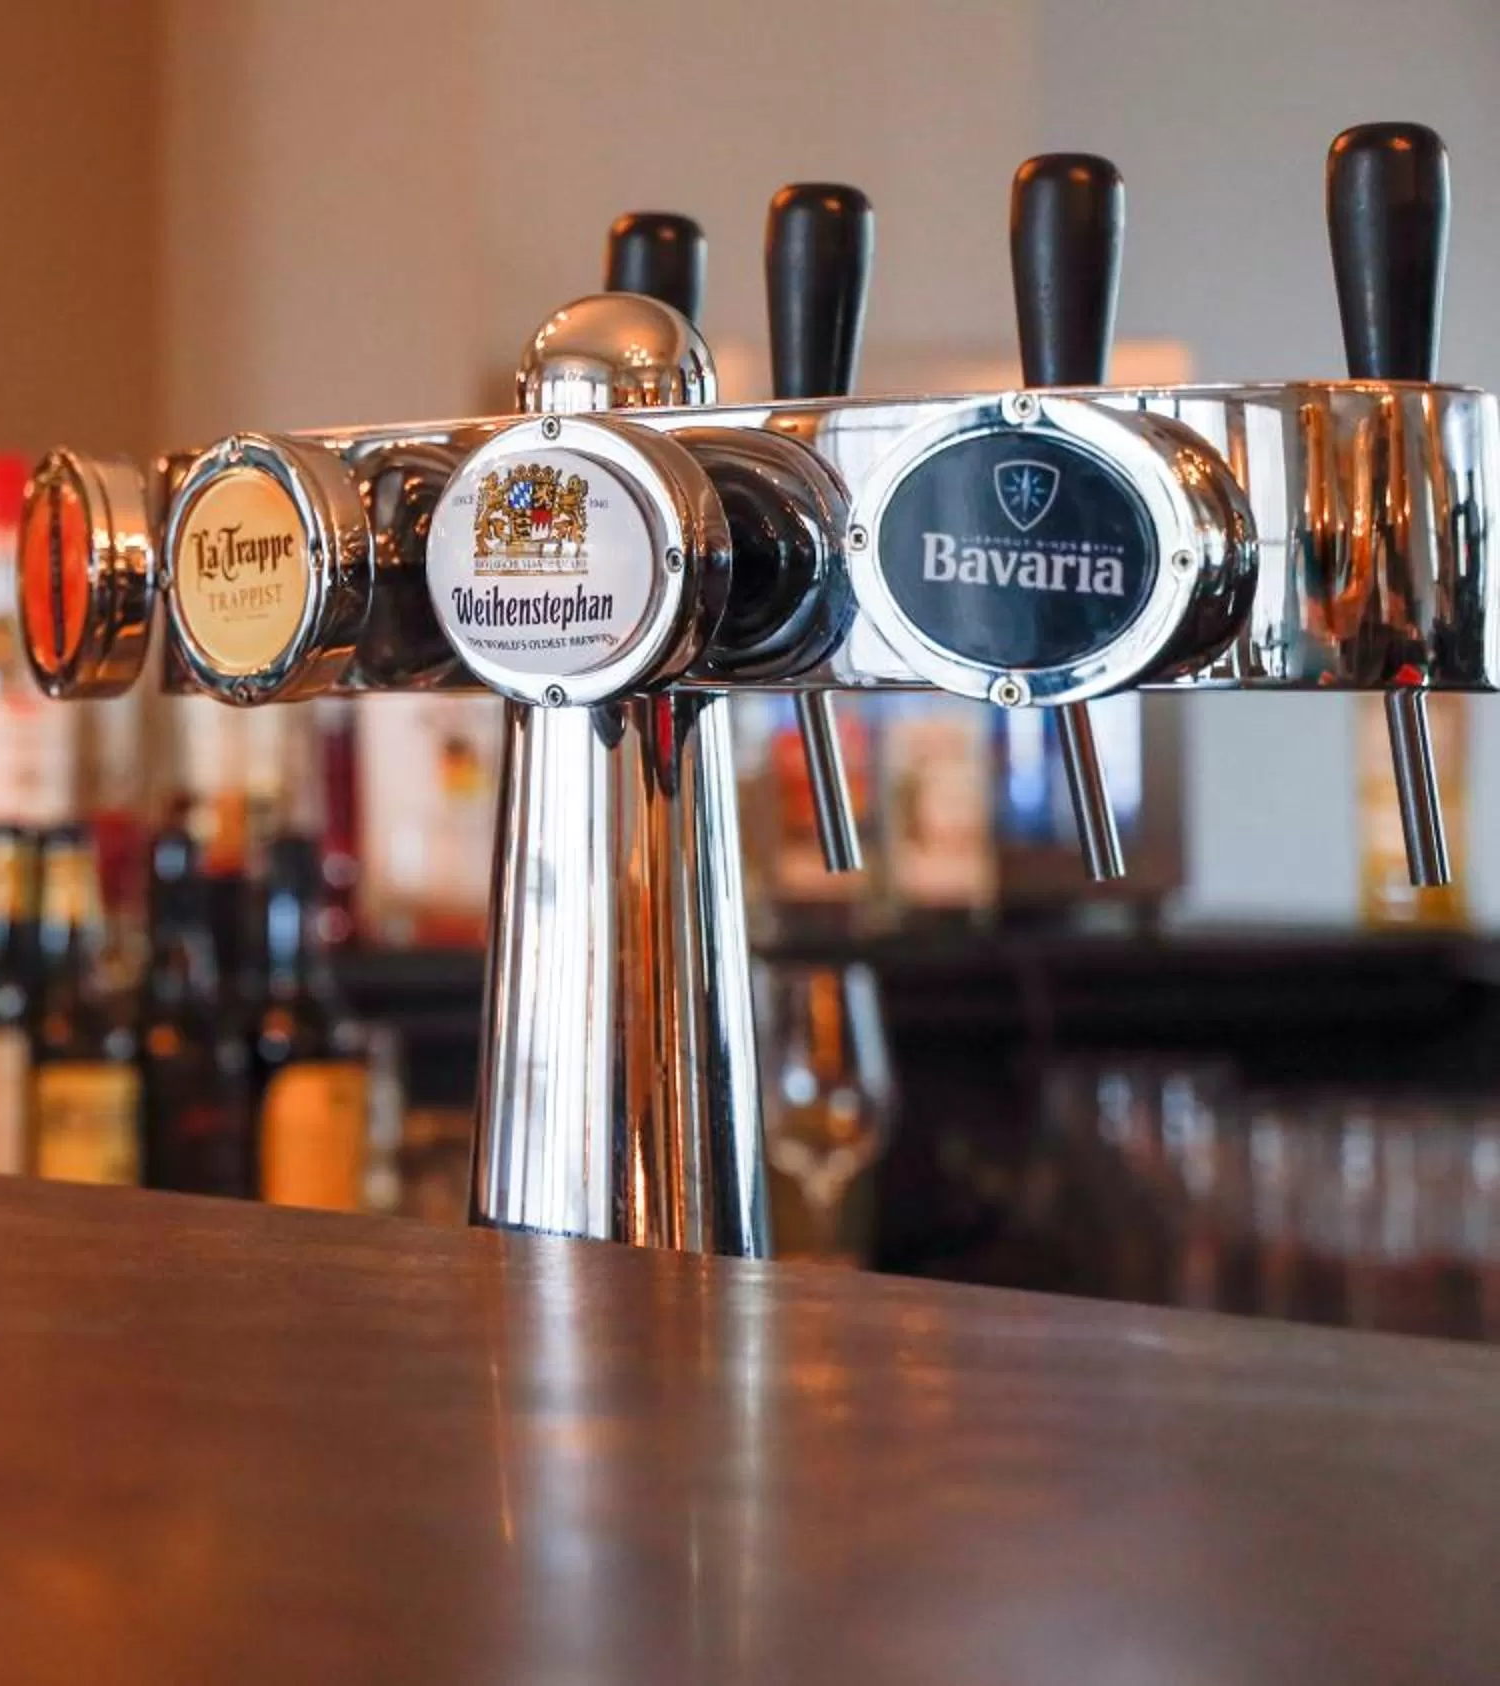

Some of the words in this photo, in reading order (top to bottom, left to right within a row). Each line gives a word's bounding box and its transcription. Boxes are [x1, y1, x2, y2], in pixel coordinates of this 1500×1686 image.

[190, 529, 218, 580] La
[217, 521, 294, 582] Trappe
[922, 532, 1126, 597] Bavaria
[207, 583, 283, 613] TRAPPIST
[451, 583, 614, 632] Weihenstephan
